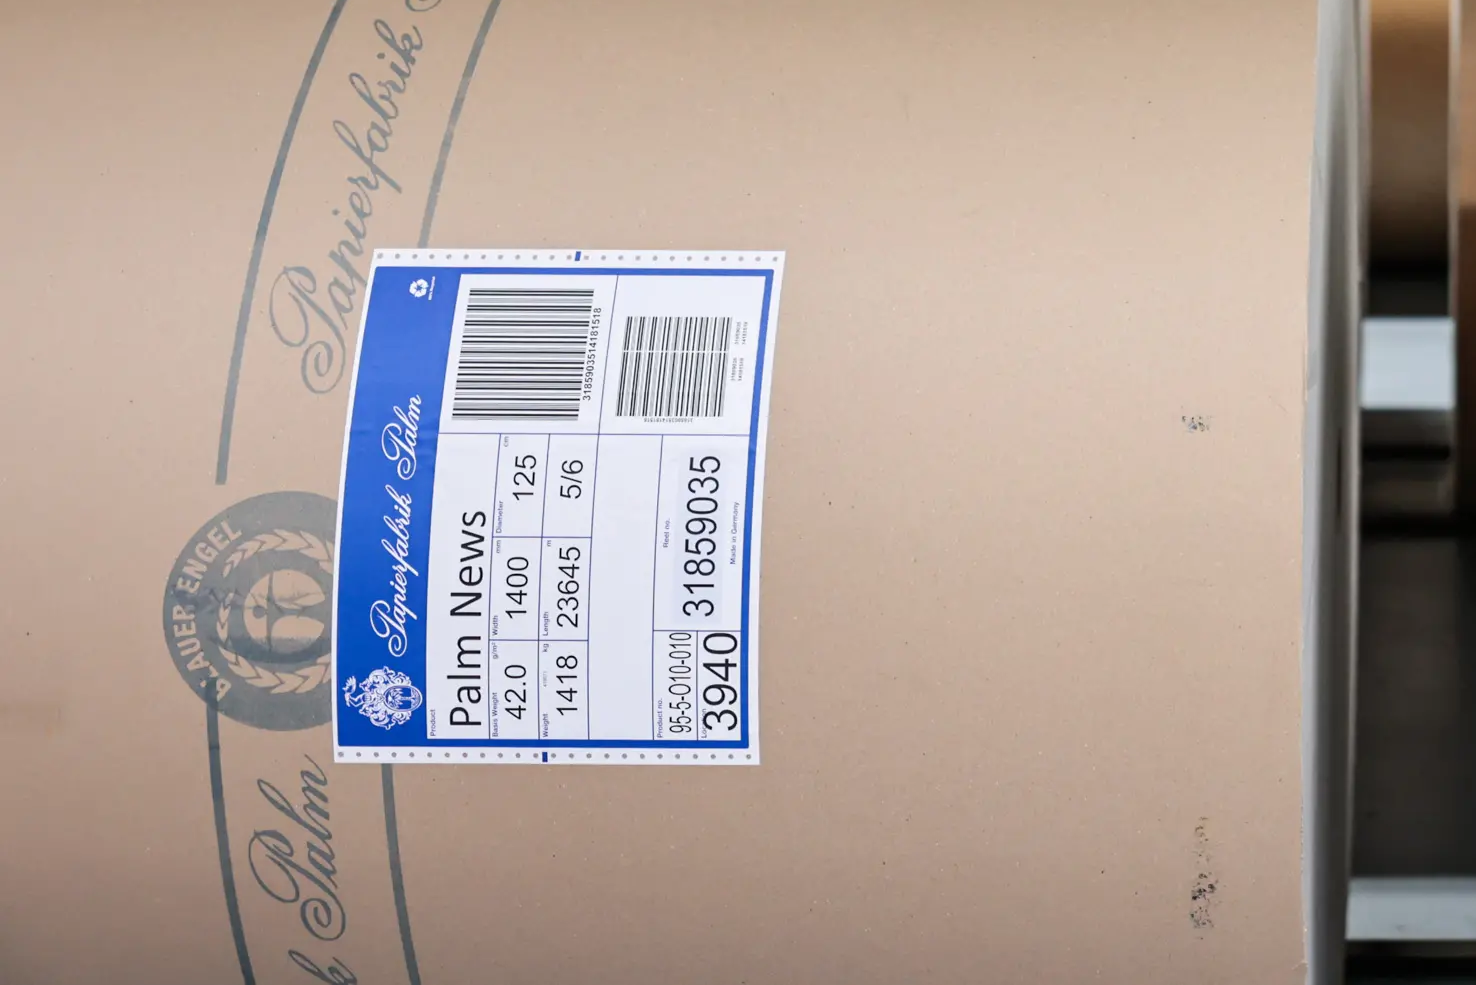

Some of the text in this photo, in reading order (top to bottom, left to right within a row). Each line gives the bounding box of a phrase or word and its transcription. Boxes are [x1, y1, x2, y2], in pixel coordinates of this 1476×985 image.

[269, 18, 425, 395] Papierfabrik
[582, 308, 601, 400] 3185903514181518
[512, 455, 536, 501] 125
[560, 460, 583, 499] 5/6
[370, 394, 422, 657] Papierfabrik Palm
[496, 501, 504, 533] Diameter
[683, 456, 720, 617] 31859035
[731, 502, 739, 534] Germany
[176, 519, 243, 595] ENGEL
[505, 557, 528, 619] 1400
[556, 547, 580, 628] 23645
[447, 511, 486, 726] Palm News
[542, 644, 549, 652] kg
[491, 692, 499, 716] Weight
[504, 665, 526, 720] 42.0
[556, 655, 578, 716] 1418
[703, 632, 737, 731] 3940
[247, 753, 346, 941] Palm
